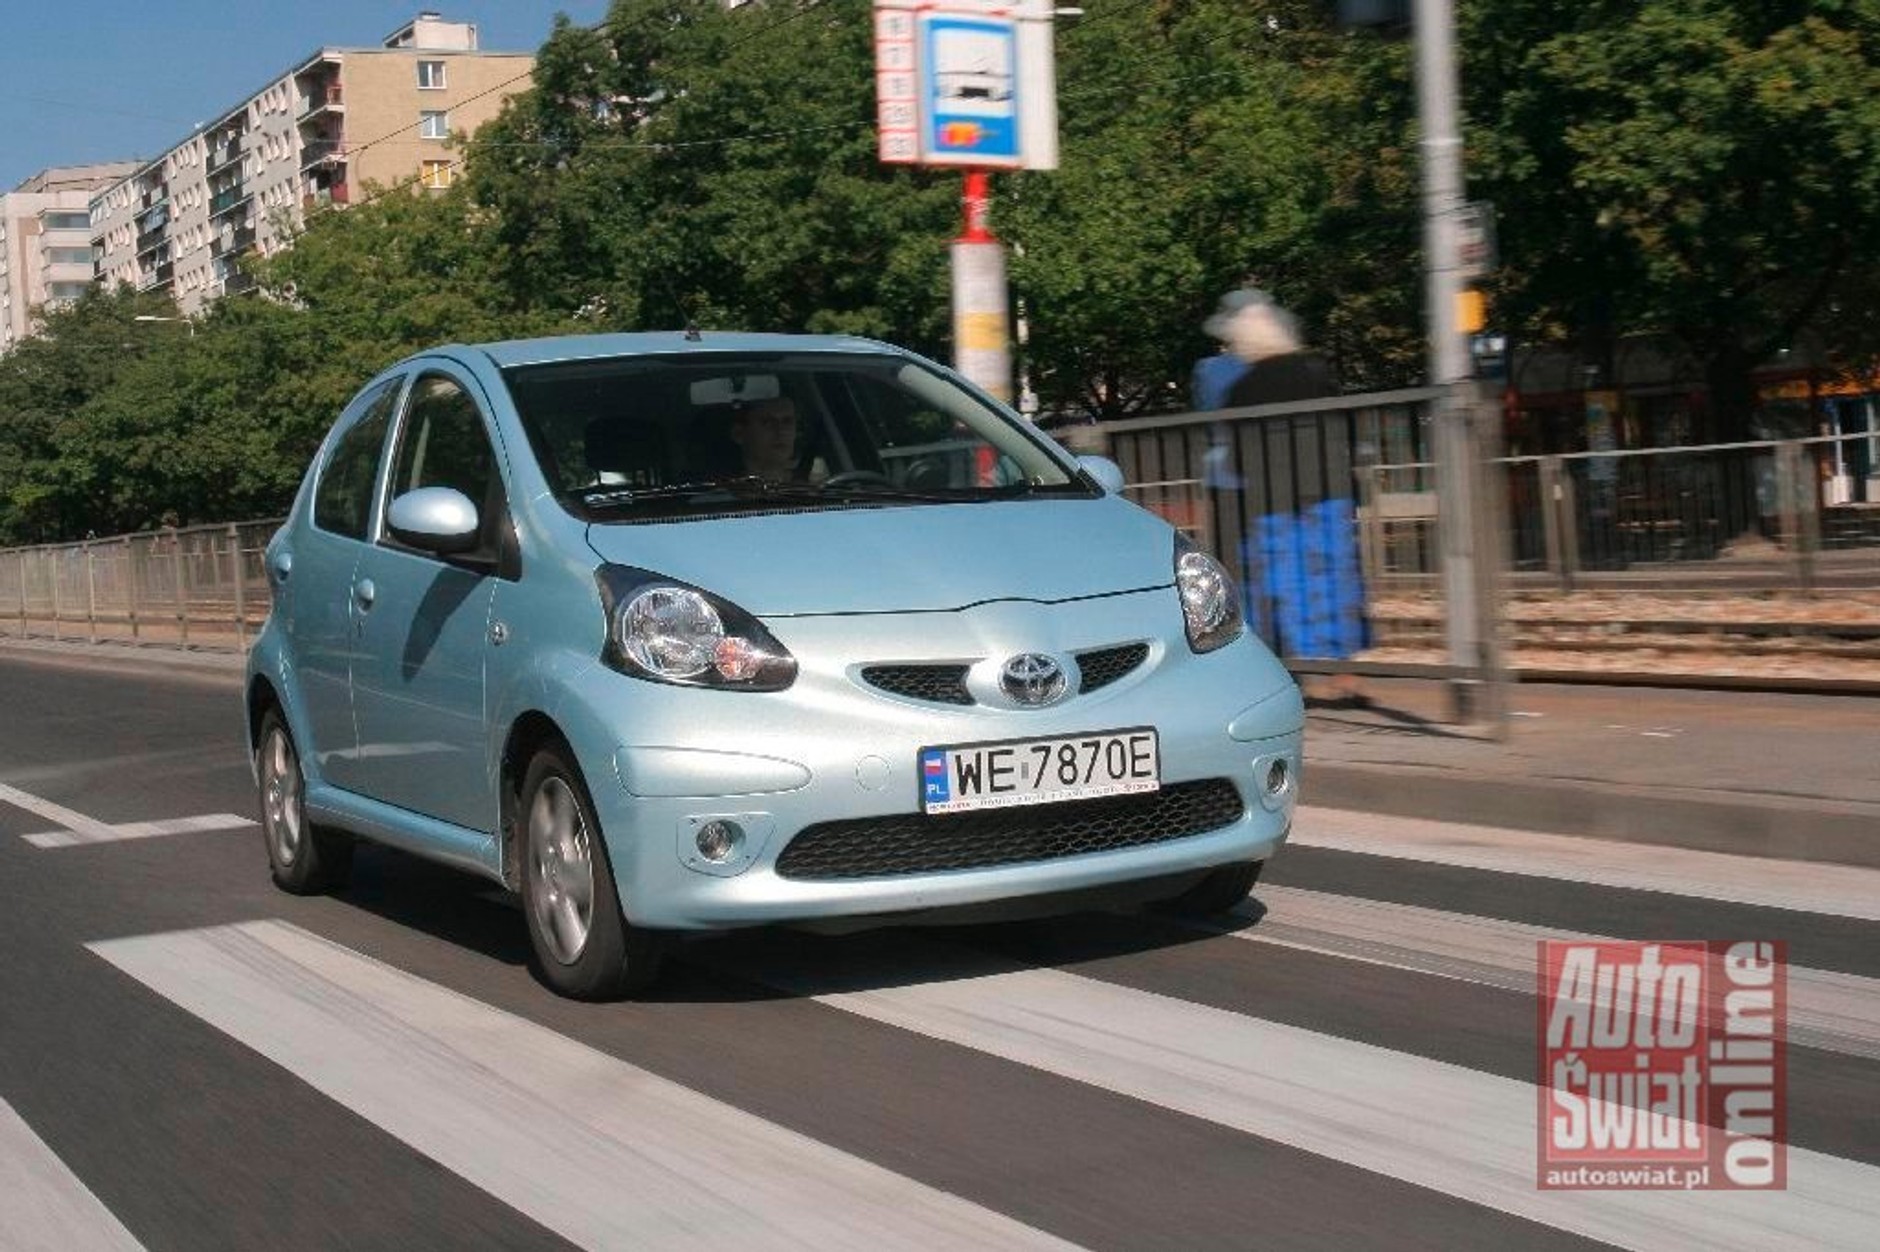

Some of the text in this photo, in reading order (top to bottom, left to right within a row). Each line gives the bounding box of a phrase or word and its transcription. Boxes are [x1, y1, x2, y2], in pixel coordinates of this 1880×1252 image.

[955, 735, 1152, 796] WE 7870E
[926, 783, 946, 796] PL
